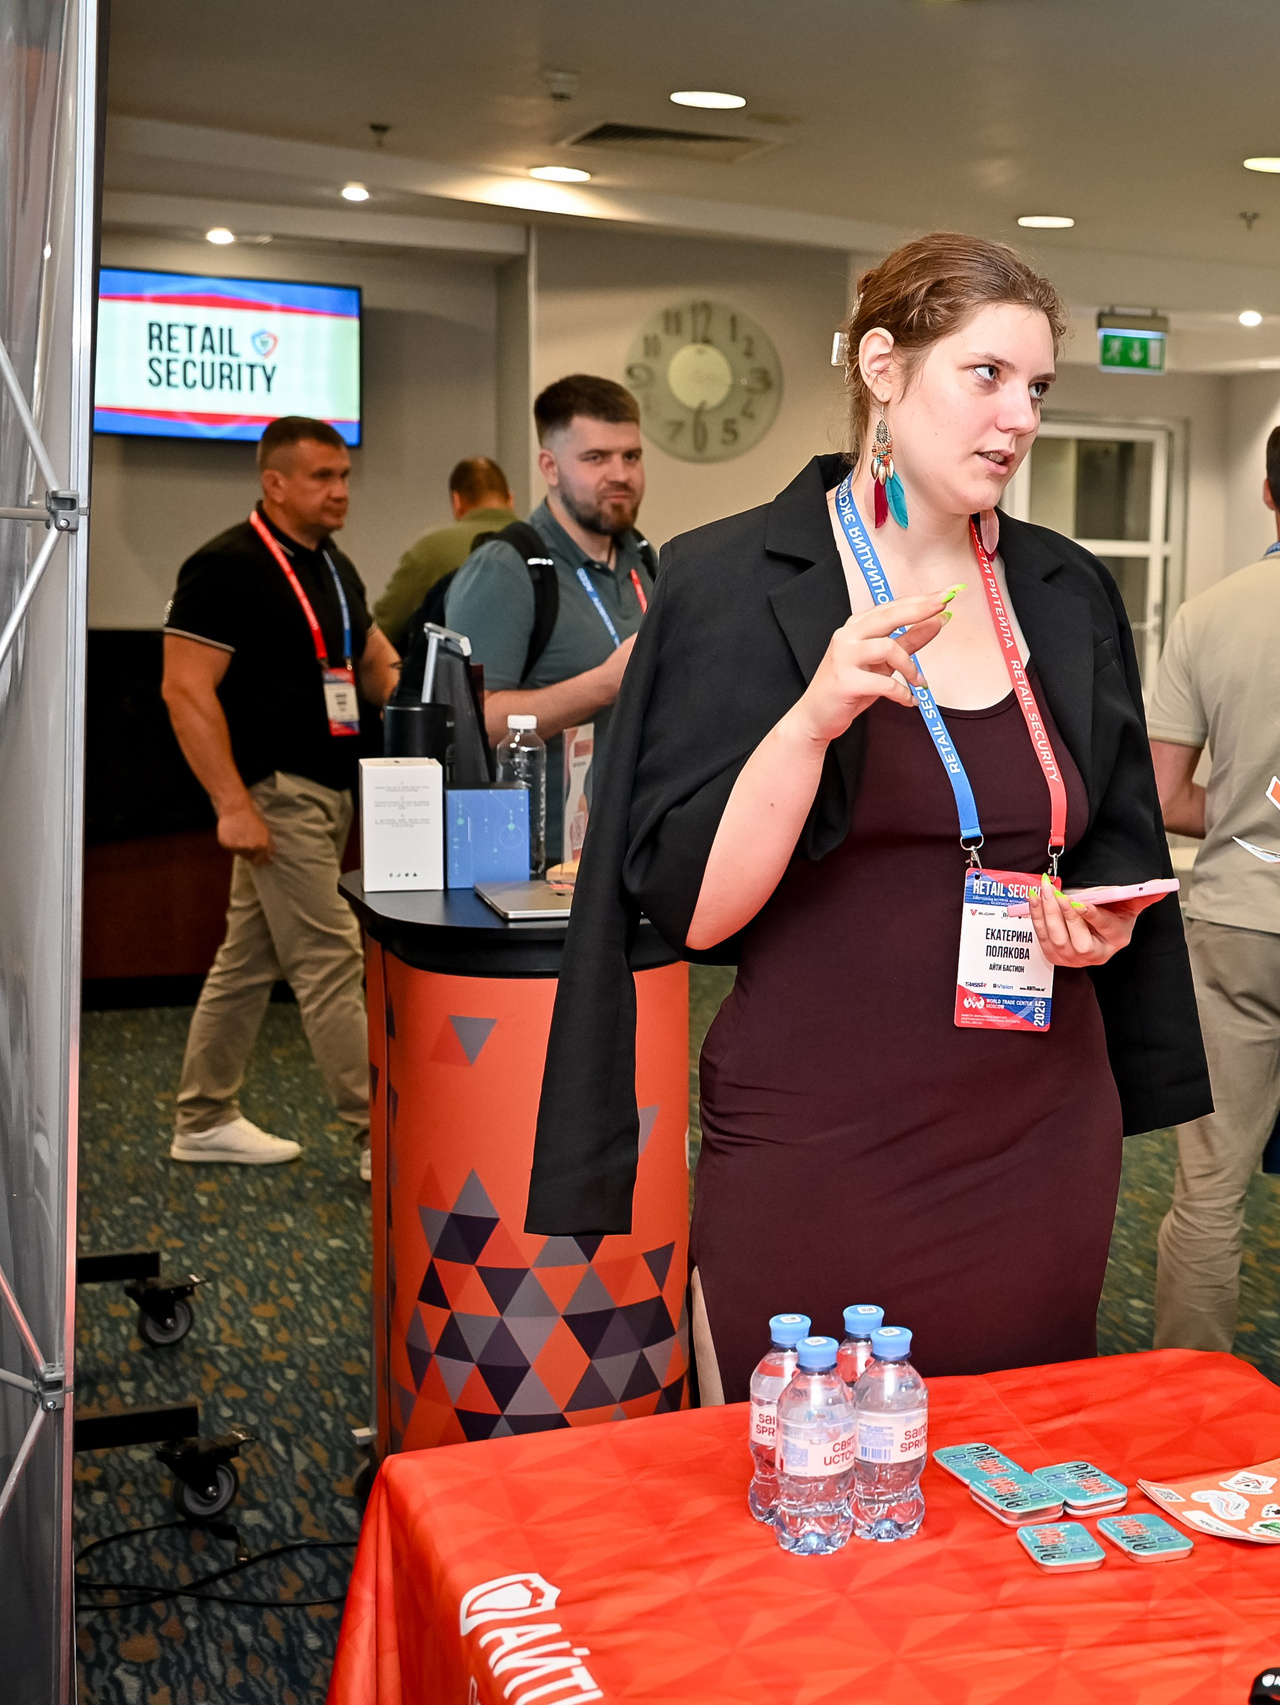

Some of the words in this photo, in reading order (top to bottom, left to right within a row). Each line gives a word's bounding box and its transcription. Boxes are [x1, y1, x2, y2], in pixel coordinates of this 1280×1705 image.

[148, 322, 240, 357] RETAIL
[691, 301, 712, 344] 12
[730, 314, 738, 342] 1
[148, 357, 277, 392] SECURITY
[721, 418, 739, 446] 5
[848, 526, 890, 605] ОЦИАЦИЯ
[986, 578, 1013, 648] РИТЕЙЛА
[1011, 660, 1034, 710] RETAIL
[1028, 713, 1060, 783] SECURITY
[931, 721, 961, 773] RETAIL
[972, 880, 1005, 897] RETAIL
[985, 928, 1033, 943] ЕКАТЕРИНА
[985, 945, 1030, 960] ПОЛЯКОВА
[989, 962, 1002, 971] АЙТИ
[1003, 964, 1025, 973] БАСТИОН
[1033, 1000, 1046, 1026] 2025
[479, 1623, 604, 1705] АЙТ
